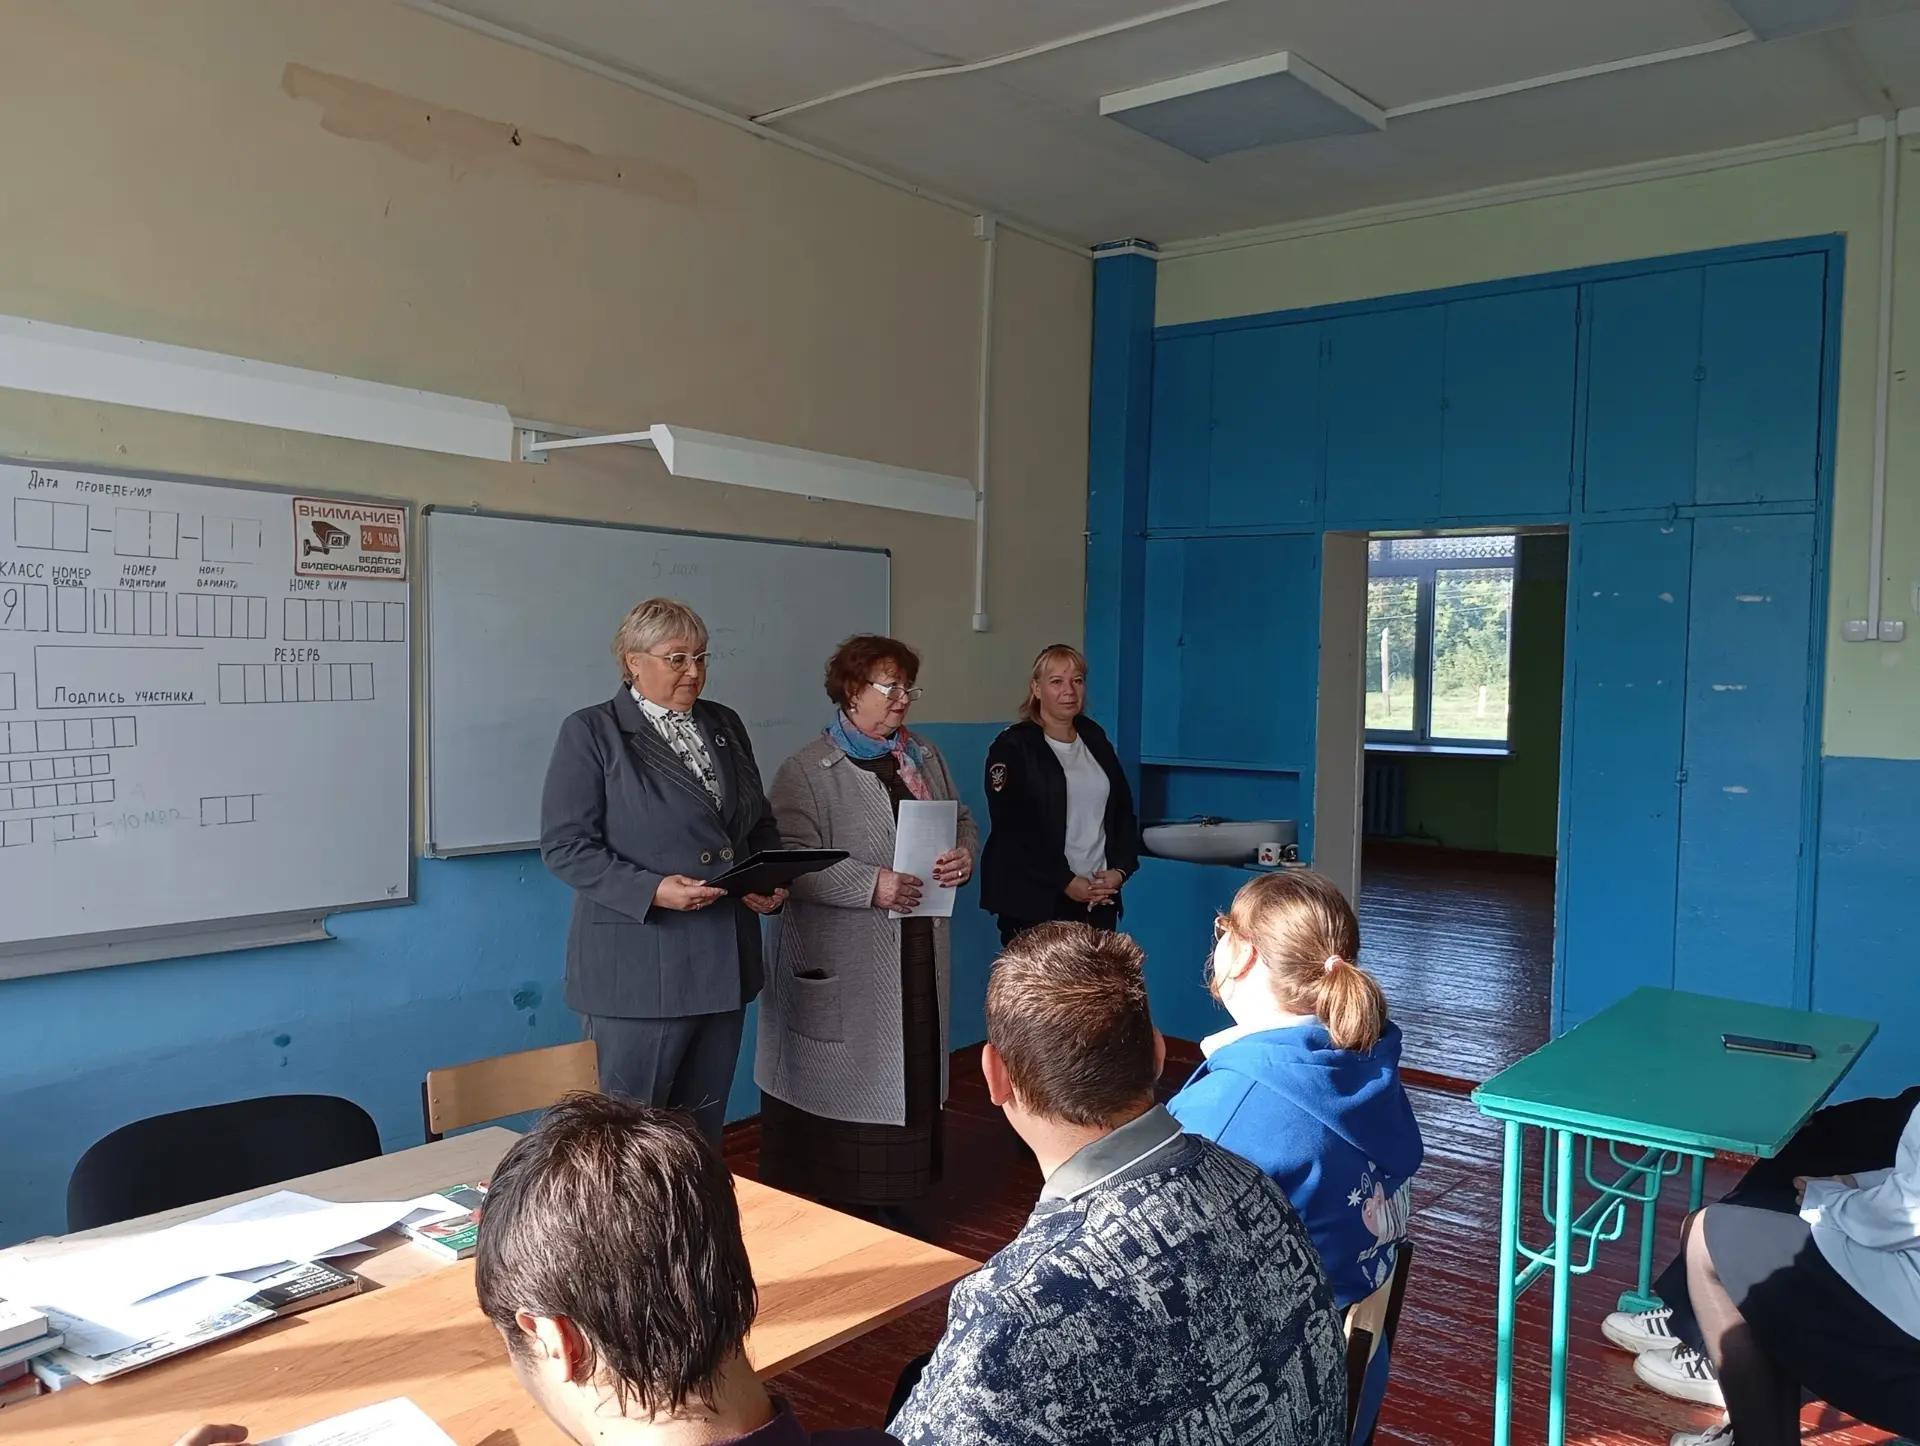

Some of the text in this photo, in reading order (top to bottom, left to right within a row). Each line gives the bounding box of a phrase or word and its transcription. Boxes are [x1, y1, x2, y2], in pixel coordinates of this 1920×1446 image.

[299, 505, 401, 524] ВНИМАНИЕ!
[362, 531, 399, 547] 24 ЧАСА
[0, 561, 45, 578] КЛАСС
[52, 566, 92, 579] НОМЕР
[123, 564, 157, 576] НОМЕР
[301, 561, 401, 575] ВИДЕОНАБЛЮДЕНИЕ
[53, 578, 84, 587] БУКВА
[119, 577, 167, 589] АУДИТОРИИ
[289, 578, 348, 592] НОМЕР КИМ
[3, 588, 18, 624] 9
[274, 648, 320, 663] РЕЗЕРВ
